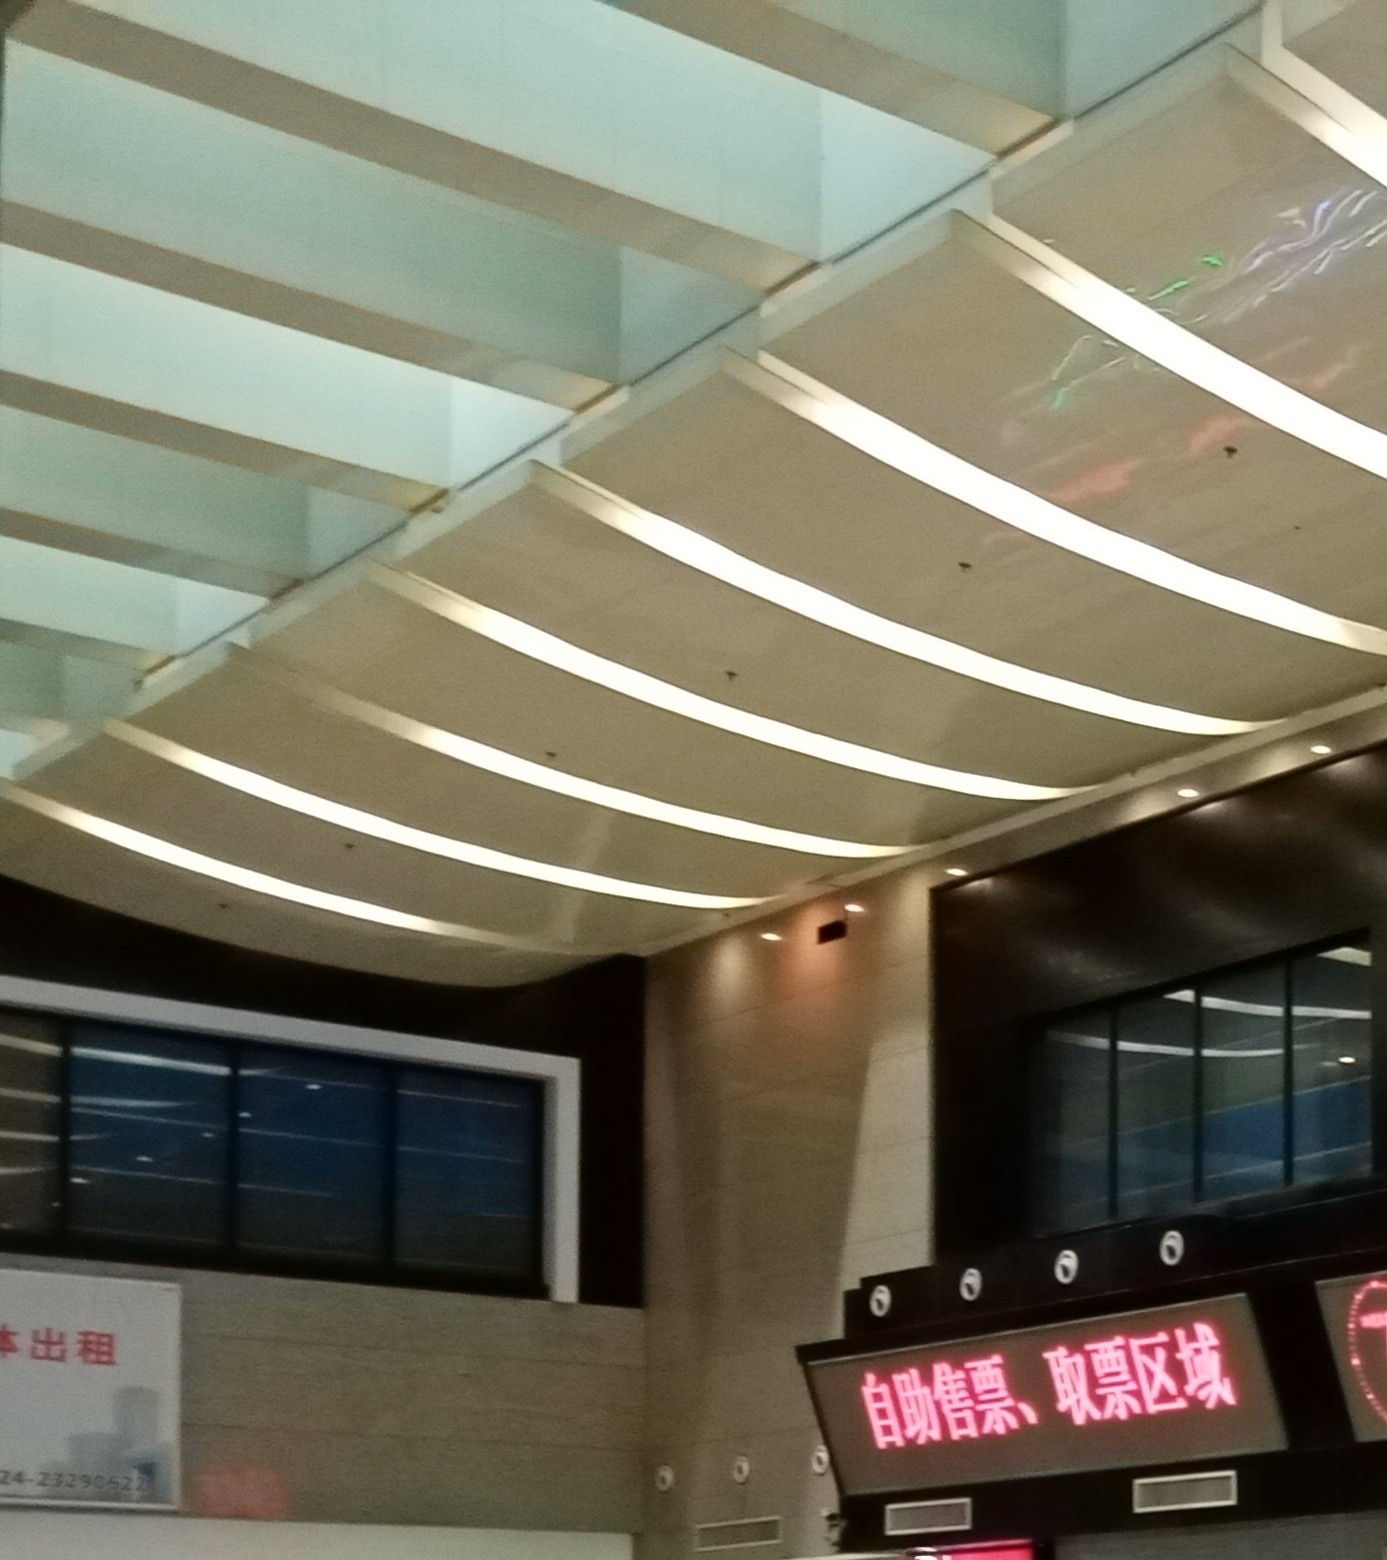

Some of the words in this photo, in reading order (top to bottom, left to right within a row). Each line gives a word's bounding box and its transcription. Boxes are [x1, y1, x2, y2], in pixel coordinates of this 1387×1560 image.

[862, 1322, 1237, 1449] 自助售票、取票区域
